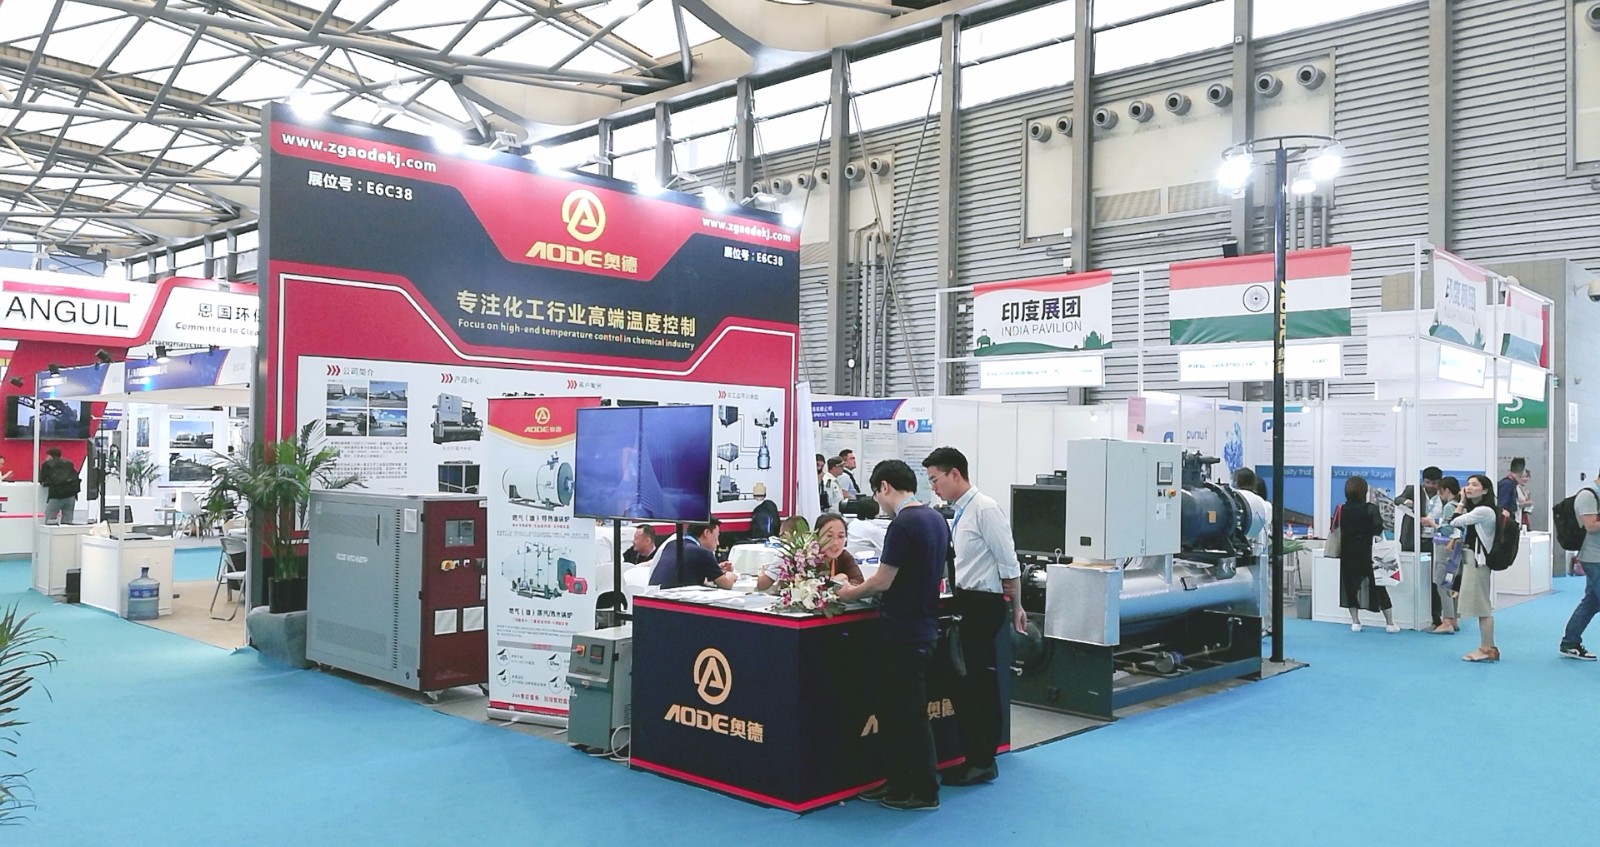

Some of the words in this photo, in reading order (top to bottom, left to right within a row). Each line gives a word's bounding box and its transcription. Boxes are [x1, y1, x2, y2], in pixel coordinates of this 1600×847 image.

[281, 133, 437, 173] www.zgaodekj.com
[702, 215, 792, 243] www.zgaodekj.com
[4, 295, 129, 328] ANGUIL
[457, 290, 696, 337] 专注化工行业高端温度控制
[1001, 295, 1081, 323] 印度展团
[175, 322, 227, 334] Committed
[458, 318, 485, 330] Focus
[486, 322, 499, 331] on
[500, 321, 541, 335] high-end
[541, 326, 593, 341] temperature
[594, 331, 623, 343] control
[623, 333, 632, 344] in
[632, 334, 665, 347] chemical
[665, 337, 696, 351] industry
[1001, 324, 1030, 337] INDIA
[1032, 320, 1082, 335] PAVILION
[1502, 416, 1526, 425] Gate
